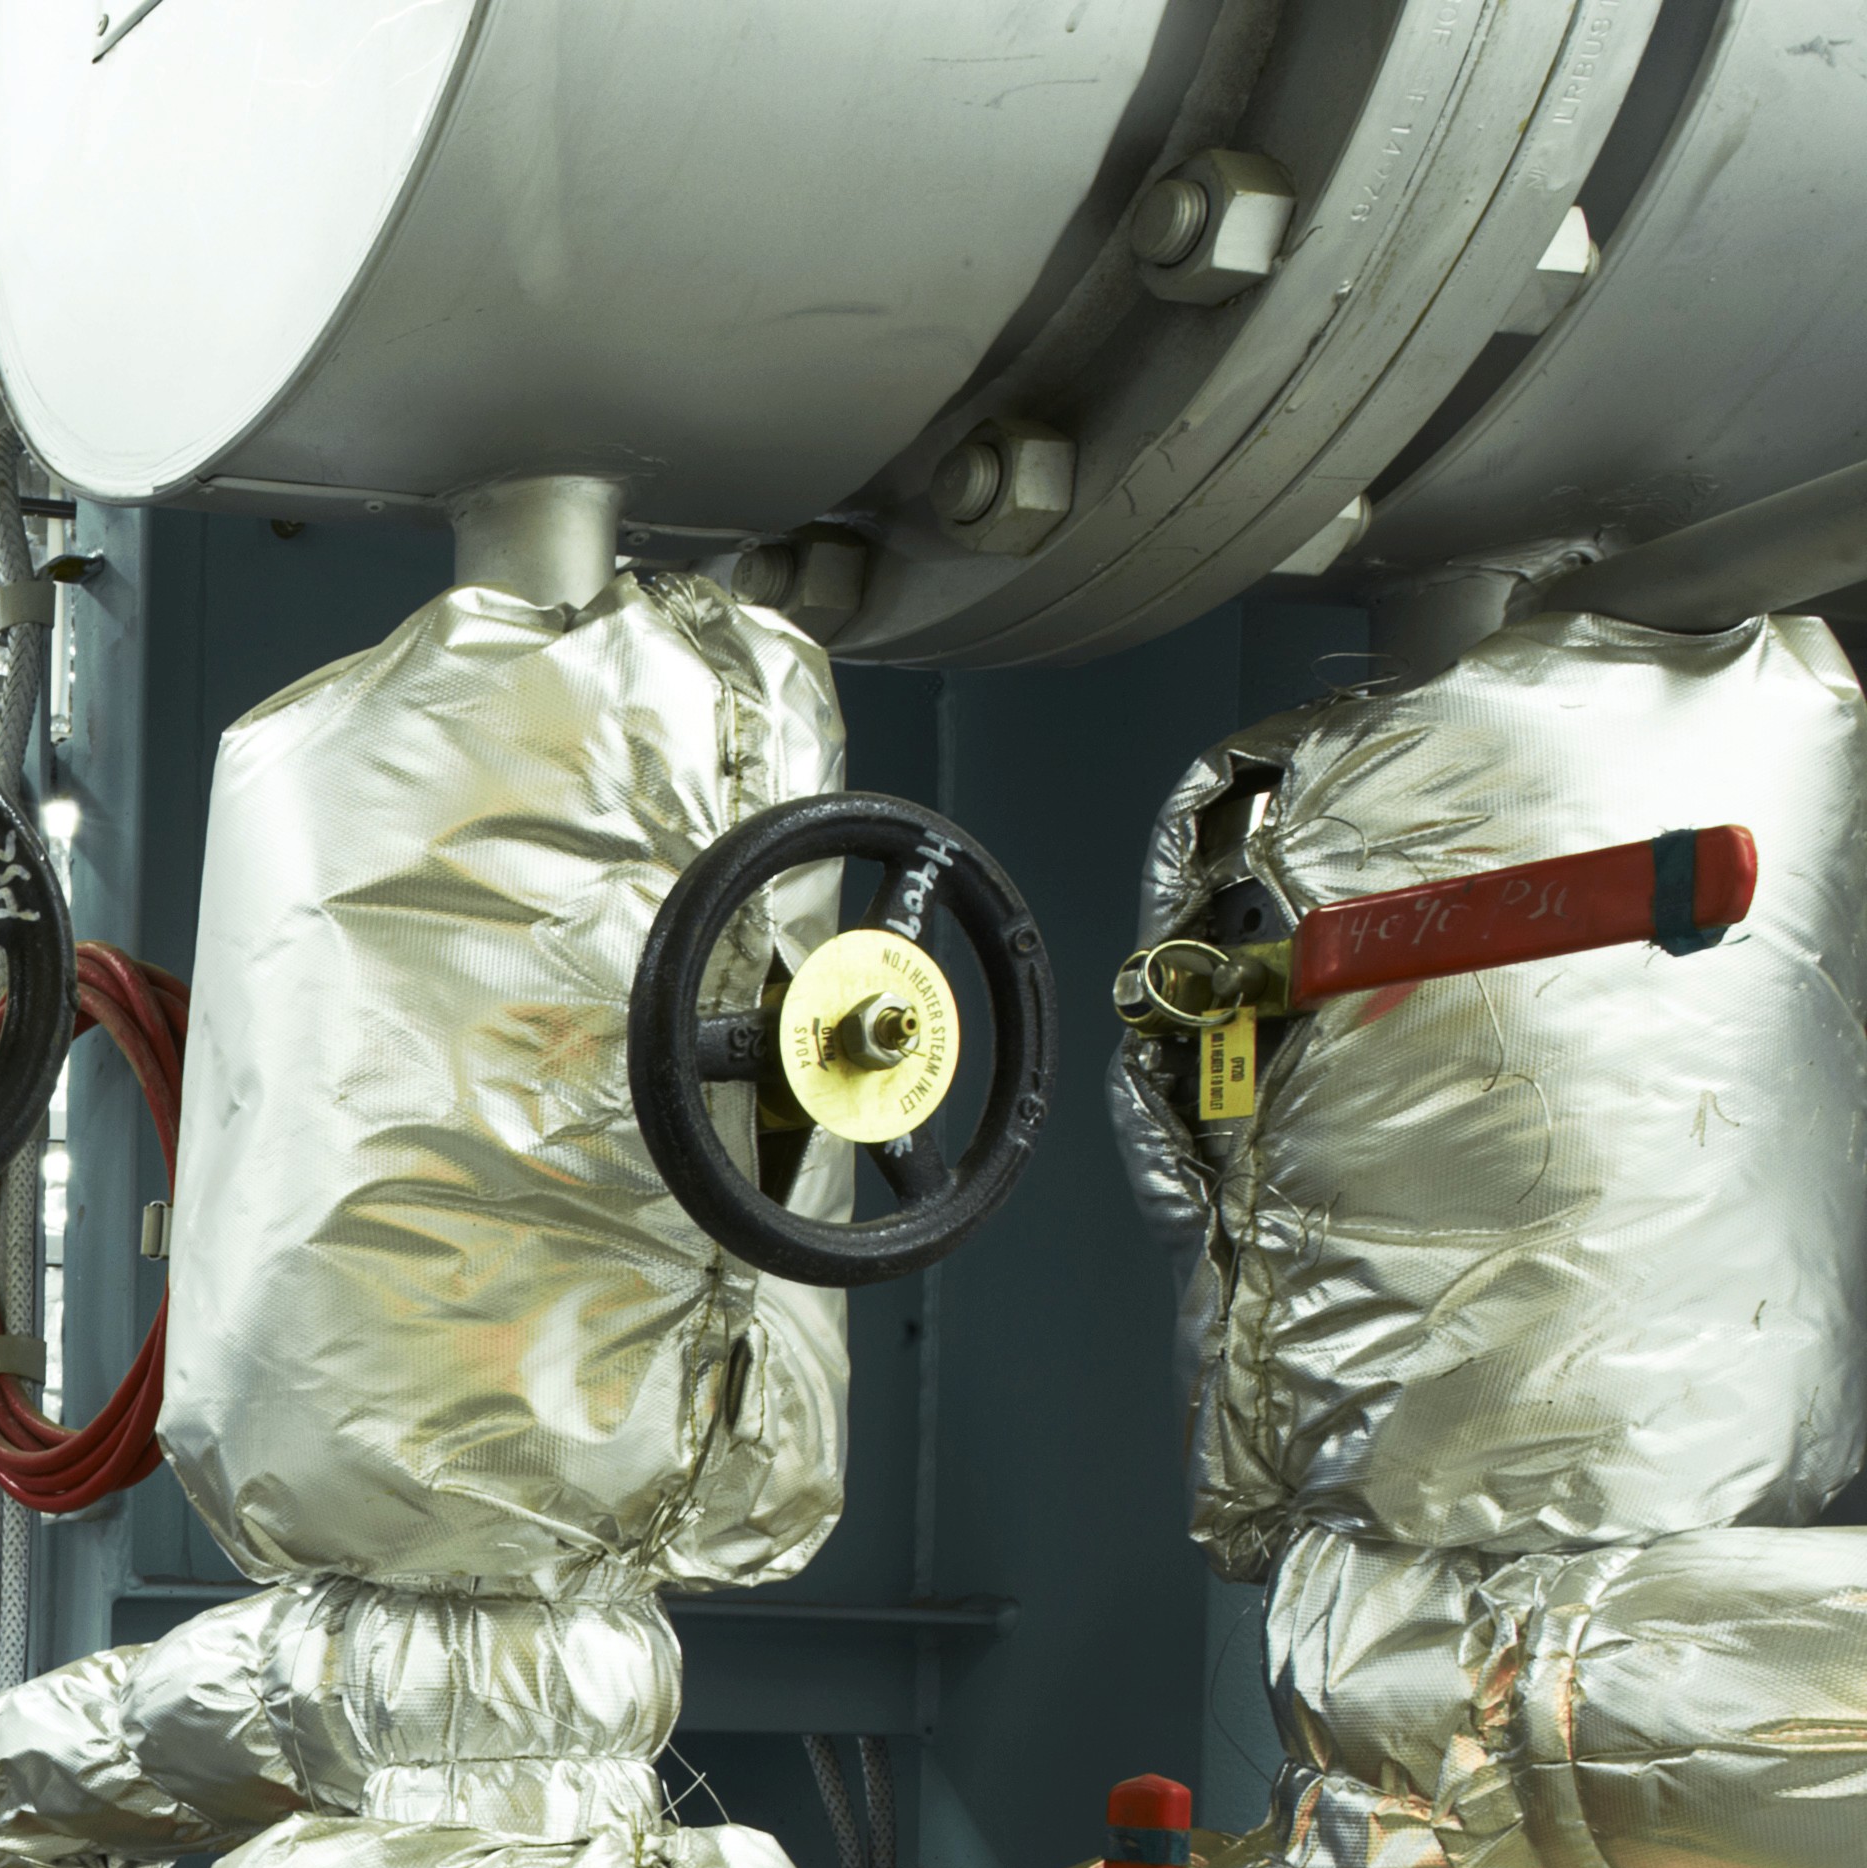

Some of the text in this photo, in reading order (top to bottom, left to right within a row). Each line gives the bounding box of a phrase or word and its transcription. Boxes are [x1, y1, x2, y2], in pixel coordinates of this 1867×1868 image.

[794, 1026, 811, 1069] SV04
[822, 1026, 836, 1061] OPEN
[882, 948, 945, 1115] NO.1 HEATER STEAM INLET
